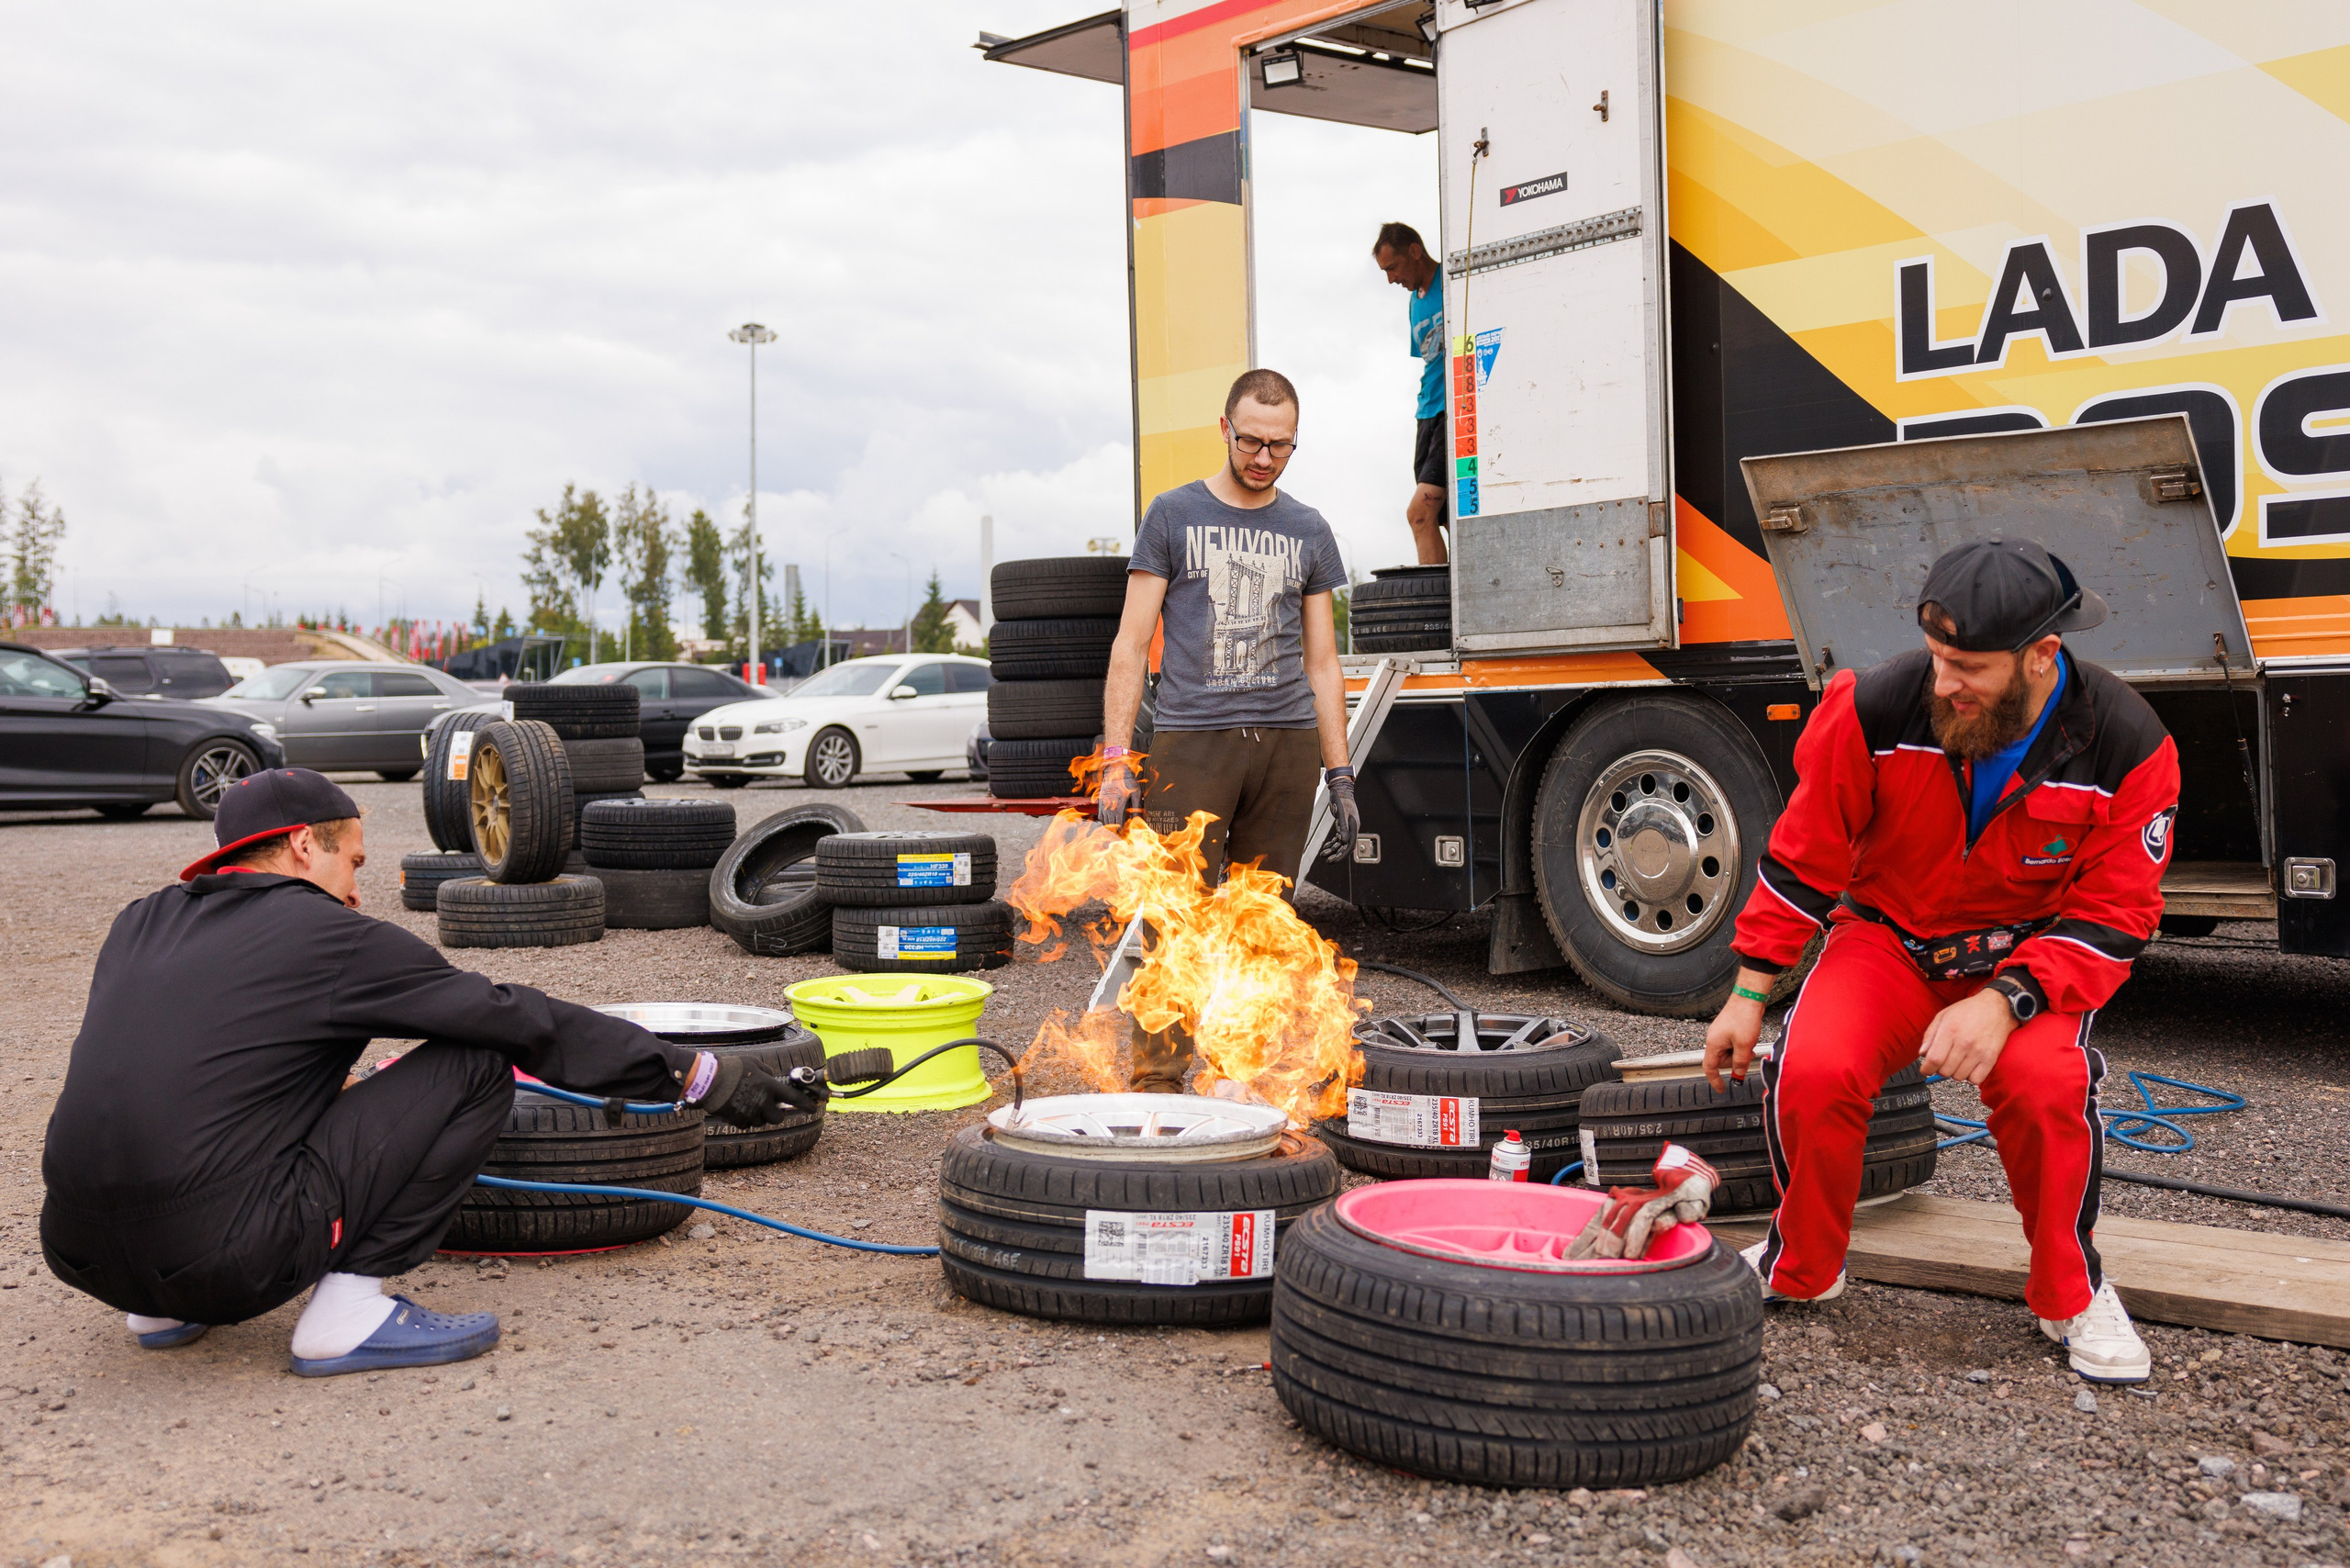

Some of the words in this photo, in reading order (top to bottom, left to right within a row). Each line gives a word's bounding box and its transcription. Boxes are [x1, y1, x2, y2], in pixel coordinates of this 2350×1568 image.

[1517, 177, 1563, 198] YOKOHAMA
[1897, 198, 2323, 378] LADA
[1466, 336, 1474, 353] 6
[1465, 356, 1474, 373] 8
[1466, 376, 1475, 393] 8
[1466, 397, 1474, 412] 3
[1467, 417, 1475, 433] 3
[1467, 438, 1475, 454] 3
[1467, 458, 1477, 475] 4
[1469, 478, 1477, 495] 5
[1470, 498, 1478, 514] 5
[1186, 525, 1304, 582] NEWYORK
[1187, 570, 1199, 579] CITY
[1201, 569, 1208, 578] OF
[1432, 1137, 1438, 1145] XL
[1468, 1129, 1476, 1145] TIRE
[1525, 1136, 1581, 1149] 35/40R18
[1222, 1215, 1231, 1243] 235/40
[1262, 1213, 1271, 1250] KUMHO
[1201, 1236, 1209, 1270] 2167333
[1234, 1233, 1242, 1257] PS91
[1220, 1244, 1230, 1265] ZR18
[1260, 1252, 1270, 1273] TIRE
[1219, 1266, 1228, 1276] XL
